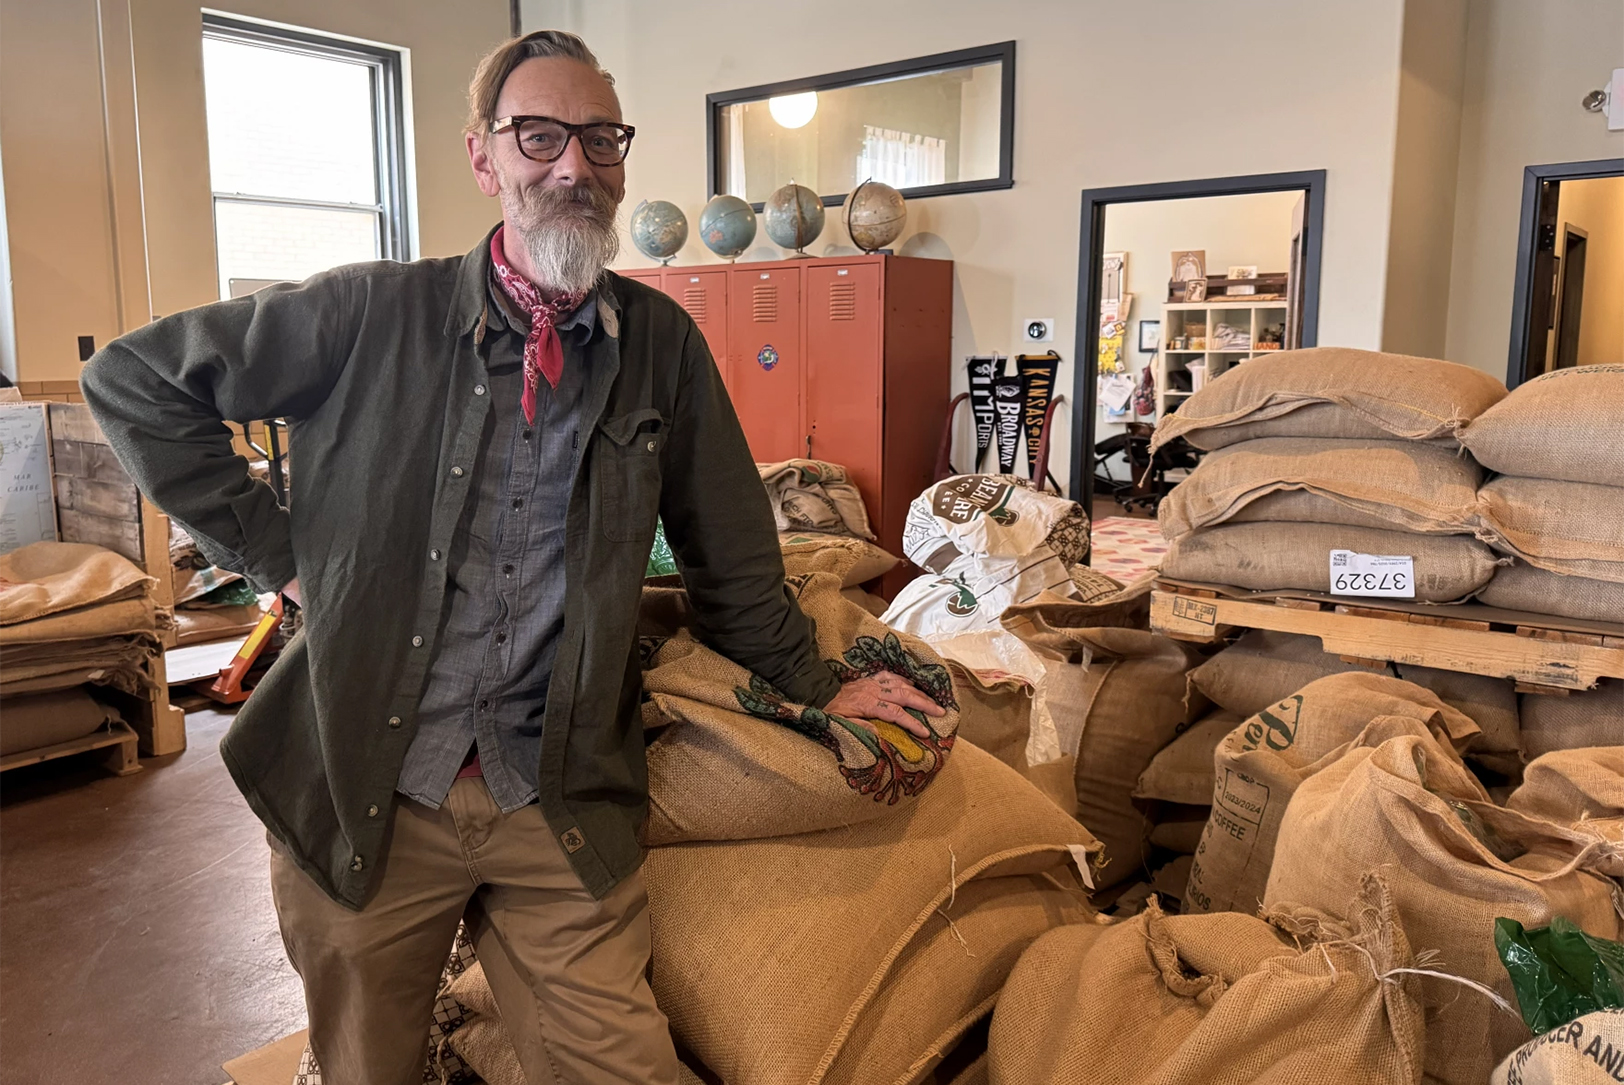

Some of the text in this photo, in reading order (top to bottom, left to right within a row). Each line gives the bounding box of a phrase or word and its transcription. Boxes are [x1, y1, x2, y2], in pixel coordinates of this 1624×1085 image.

[1022, 368, 1052, 426] KANSAS
[995, 401, 1021, 467] BROADWAY
[1335, 573, 1406, 590] 37329
[1224, 791, 1261, 814] 2023/2024
[1215, 809, 1246, 841] COFFEE
